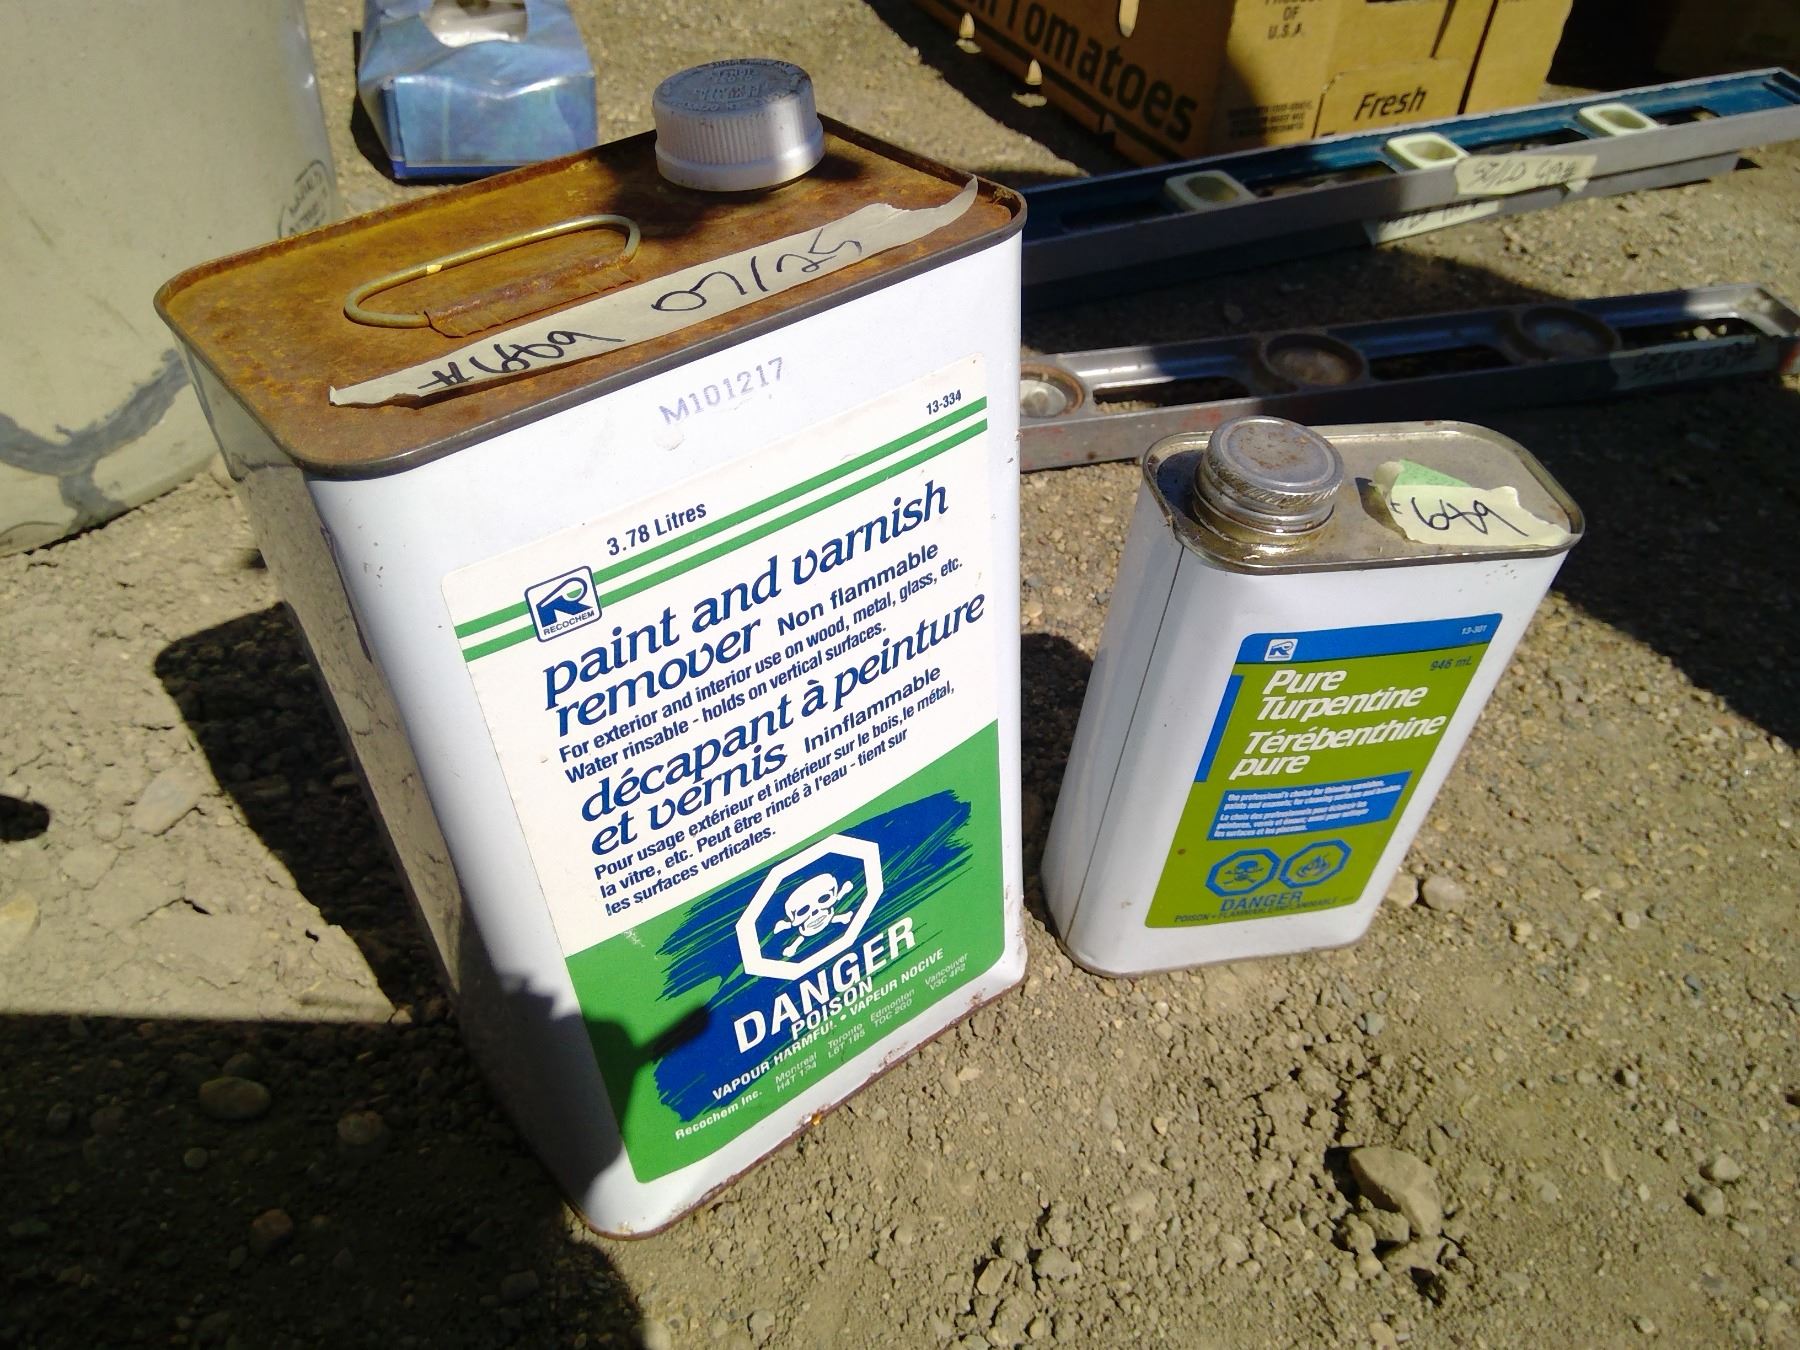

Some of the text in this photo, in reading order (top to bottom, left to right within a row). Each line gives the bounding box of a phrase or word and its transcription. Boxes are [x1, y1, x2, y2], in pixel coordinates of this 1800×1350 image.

[1282, 6, 1299, 21] OF
[1353, 86, 1427, 121] Fresh
[658, 356, 784, 425] M101217
[926, 388, 963, 416] 13-334
[606, 503, 708, 557] 3.78 Litres
[542, 480, 949, 711] paint and varnish
[542, 610, 596, 637] RECOCHEM
[555, 543, 939, 738] remover Non flammable
[559, 555, 963, 764] For exterior and interior use on wood, metal, glass, etc.
[564, 626, 887, 784] Water rinsable holds on vertical surfaces.
[581, 592, 985, 823] décapant à peinture
[1256, 686, 1429, 723] Turpentine
[1262, 669, 1347, 695] Pure
[591, 665, 941, 856] et vernis Ininflammable
[1228, 753, 1311, 781] pure
[1243, 714, 1448, 755] Térébenthine
[593, 680, 955, 881] Pour usage extérieur et intérieur sur le bois, le métal,
[600, 728, 908, 899] la vitre, etc. Peut être rincé à l'eau tient sur
[604, 826, 777, 918] les surfaces verticales.
[1219, 890, 1304, 912] DANGER
[1174, 912, 1209, 923] POISON
[733, 916, 916, 1054] DANGER
[790, 976, 873, 1041] POISON
[675, 953, 968, 1140] Recochem Inc. Montreal Toronto Edmonton Vancouver
[712, 1061, 771, 1101] VAPOUR
[849, 979, 898, 1016] VAPEUR
[901, 948, 944, 985] NOCIVE
